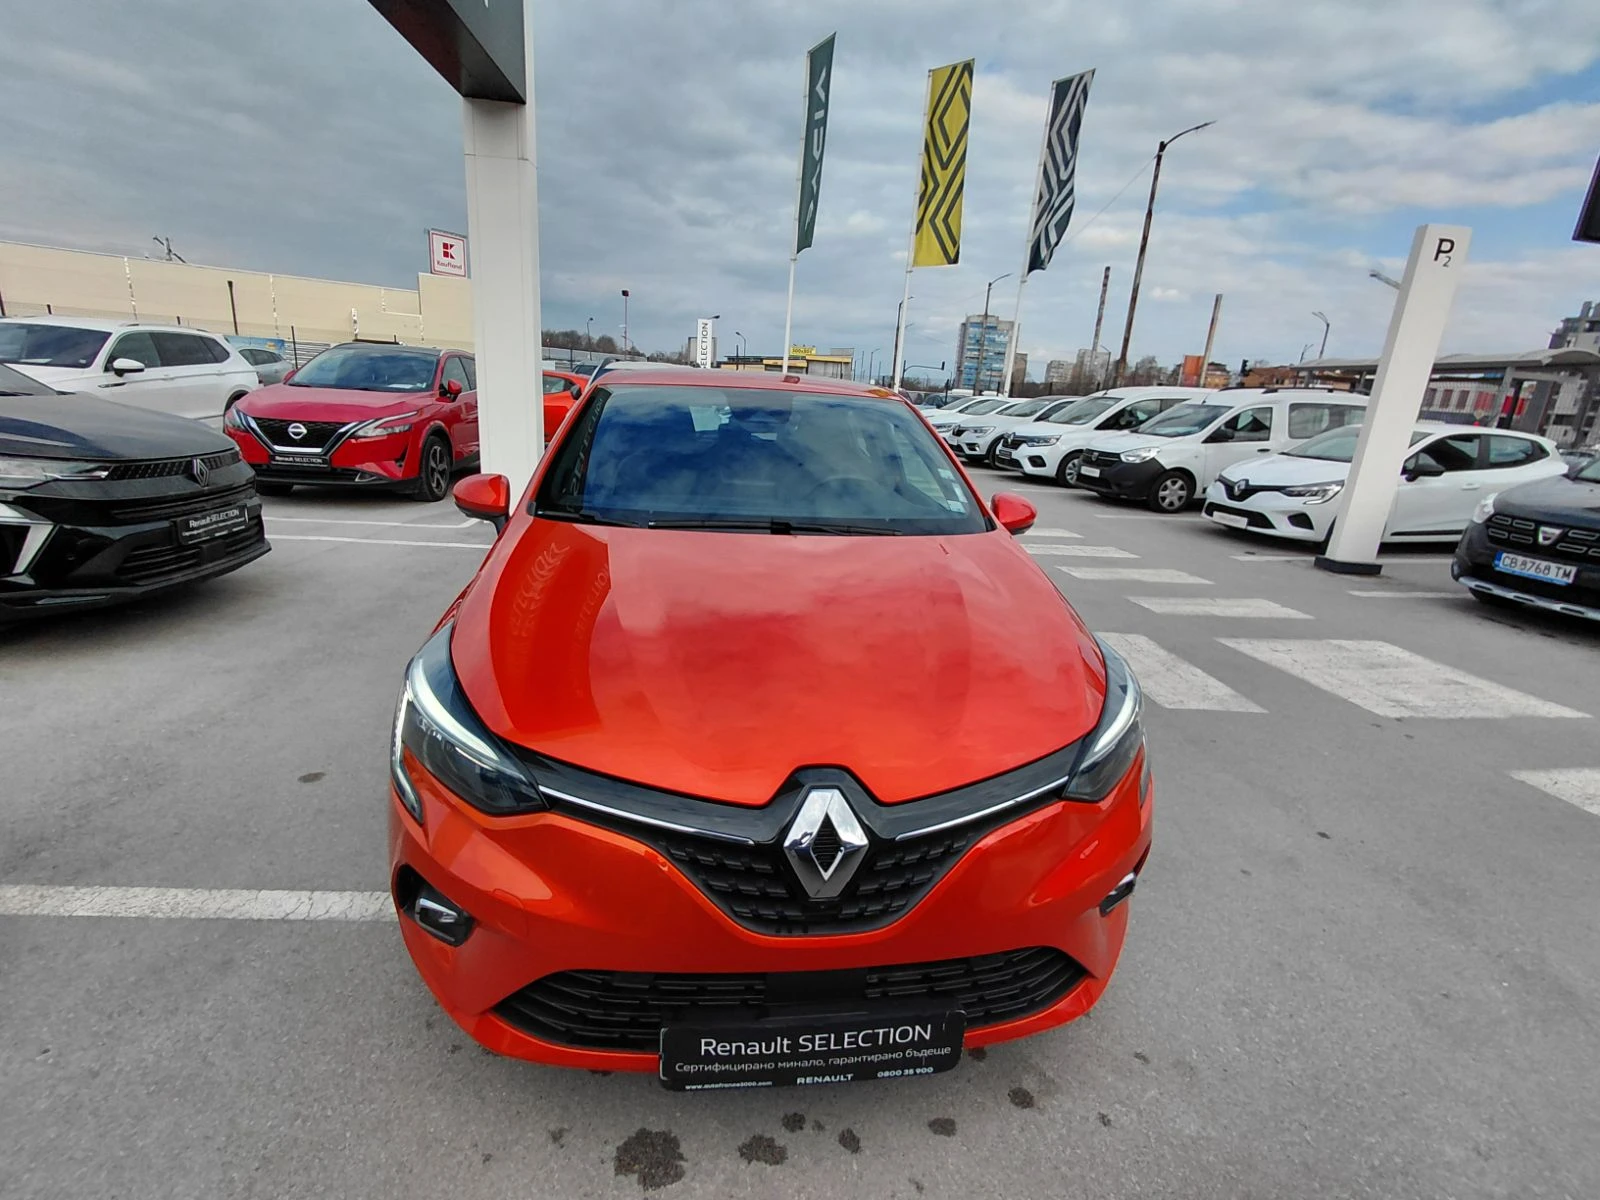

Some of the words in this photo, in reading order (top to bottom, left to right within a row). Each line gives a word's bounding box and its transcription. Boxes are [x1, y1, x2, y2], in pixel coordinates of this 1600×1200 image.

[700, 322, 709, 369] ELECTION
[210, 508, 240, 523] SELECTION
[1519, 559, 1551, 576] 8768
[700, 1036, 792, 1056] Renault
[798, 1023, 932, 1053] SELECTION
[675, 1061, 775, 1074] Сертифицирано
[777, 1059, 826, 1069] минало,
[828, 1052, 903, 1067] гарантирано
[905, 1045, 952, 1060] бъдеще
[796, 1073, 855, 1085] RENAULT
[877, 1070, 903, 1079] 0800
[915, 1066, 934, 1075] 900
